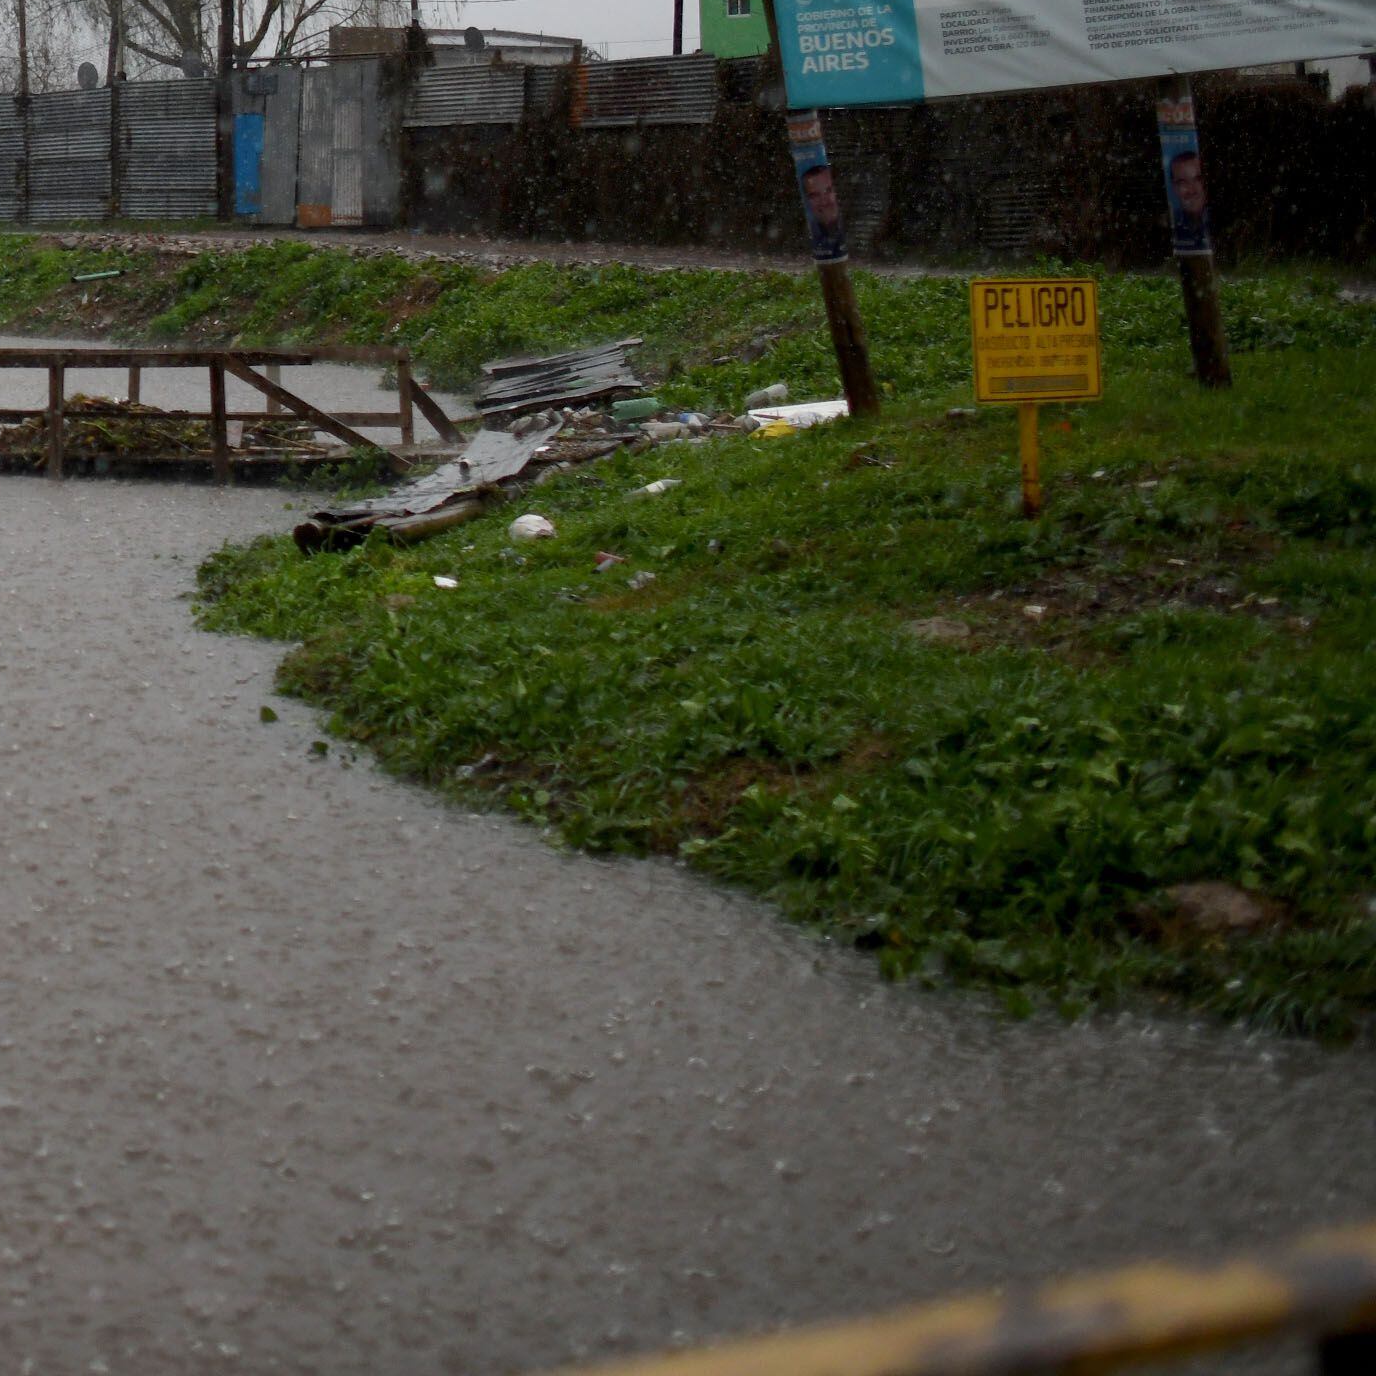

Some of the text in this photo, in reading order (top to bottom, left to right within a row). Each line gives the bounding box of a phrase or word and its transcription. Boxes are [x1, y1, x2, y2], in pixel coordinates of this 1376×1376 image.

[796, 4, 892, 22] GOBIERNO DE LA
[940, 9, 980, 20] PARTIDO:
[1085, 10, 1143, 24] DESCRIPCIÓN
[1145, 9, 1157, 18] DE
[1158, 8, 1170, 16] LA
[797, 17, 877, 34] PROVINCIA DE
[941, 17, 992, 29] LOCALIDAD:
[942, 27, 977, 38] BARRIO:
[1088, 29, 1142, 42] ORGANISMO
[799, 27, 896, 54] BUENOS
[943, 35, 993, 47] INVERSIÓN:
[1089, 41, 1110, 51] TIPO
[1110, 40, 1124, 49] DE
[944, 46, 973, 55] PLAZO
[974, 44, 987, 53] DE
[987, 42, 1015, 52] OBRA:
[801, 51, 870, 74] AIRES
[983, 286, 1087, 328] PELIGRO
